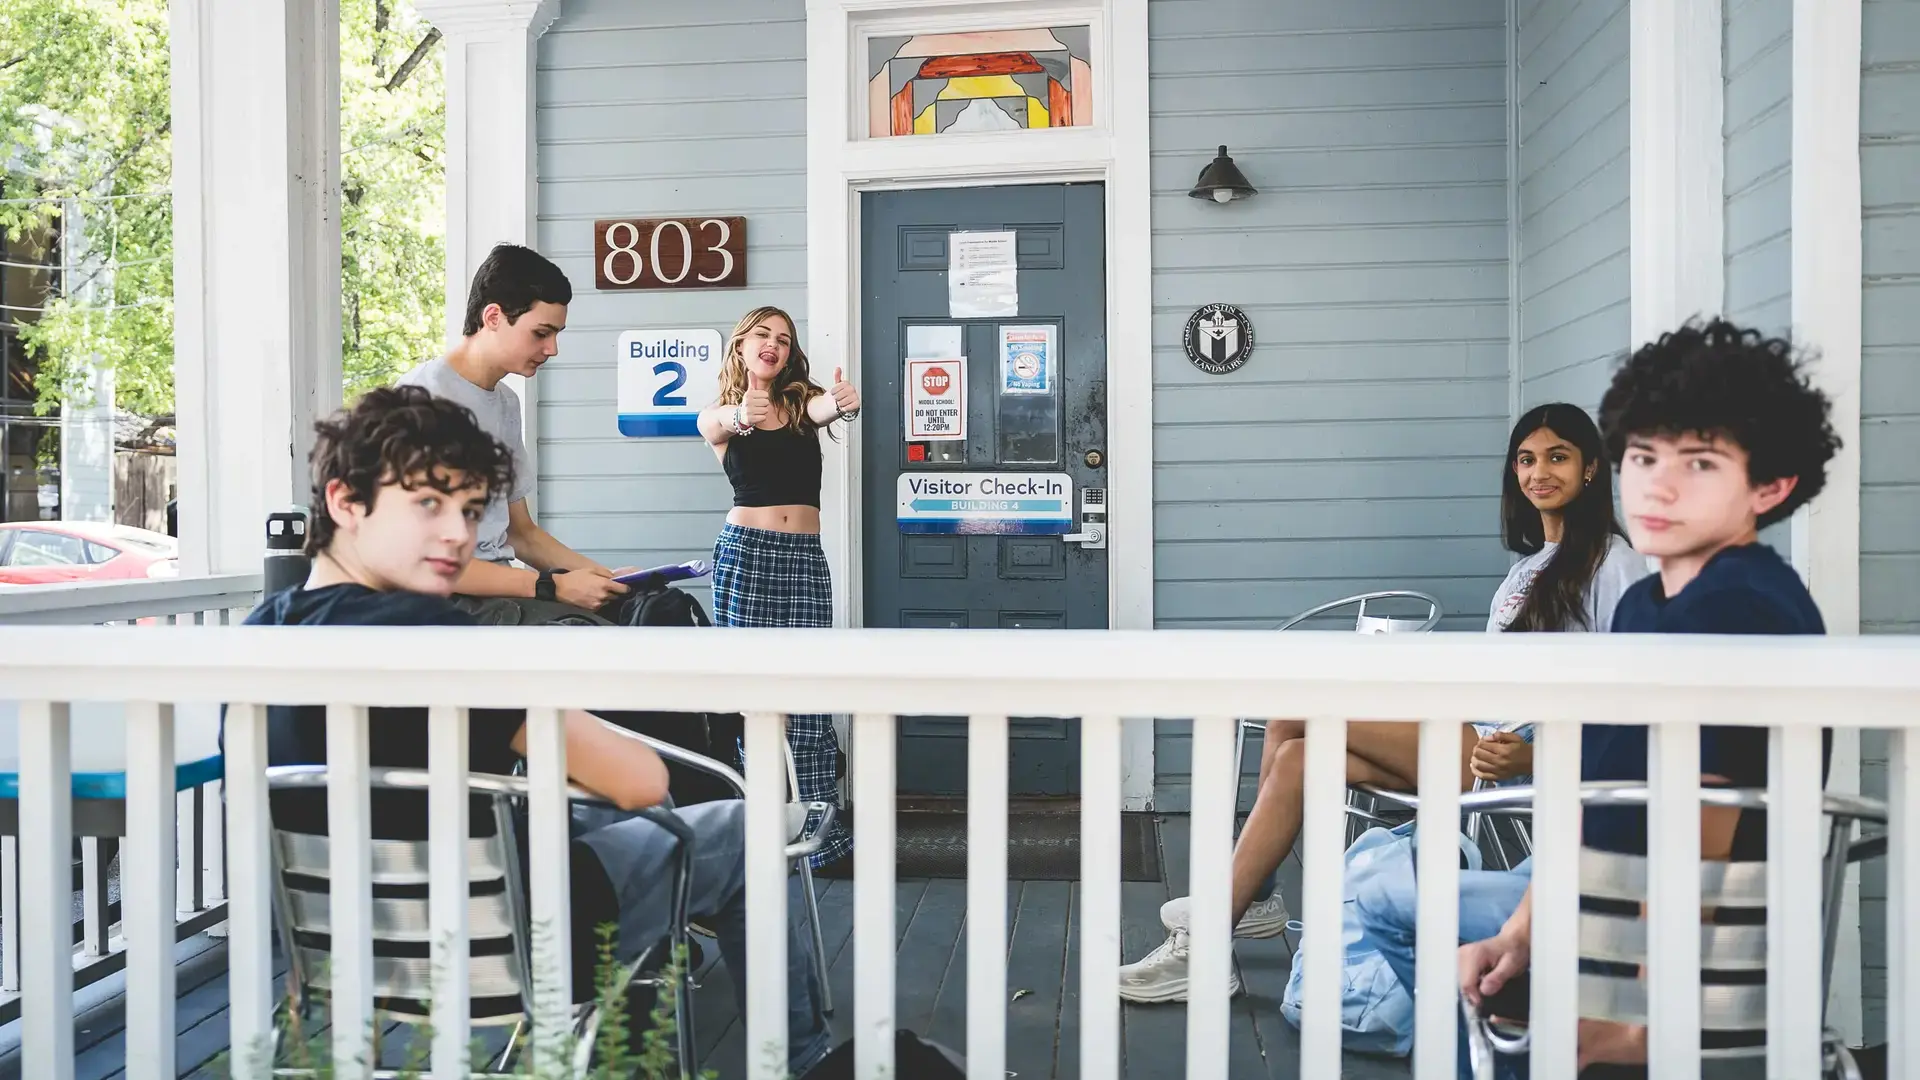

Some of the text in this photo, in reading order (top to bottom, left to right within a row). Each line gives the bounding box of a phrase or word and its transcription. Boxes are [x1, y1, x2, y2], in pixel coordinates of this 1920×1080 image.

[603, 219, 734, 285] 803
[1203, 304, 1235, 315] AUSTIN
[630, 339, 709, 361] Building
[1194, 358, 1243, 372] LANDMARK
[652, 361, 687, 406] 2
[923, 376, 948, 387] STOP
[915, 408, 958, 417] DO NOT ENTER
[928, 416, 945, 424] UNTIL
[908, 477, 1063, 495] Visitor Check-In
[951, 501, 1020, 511] BUILDING 4
